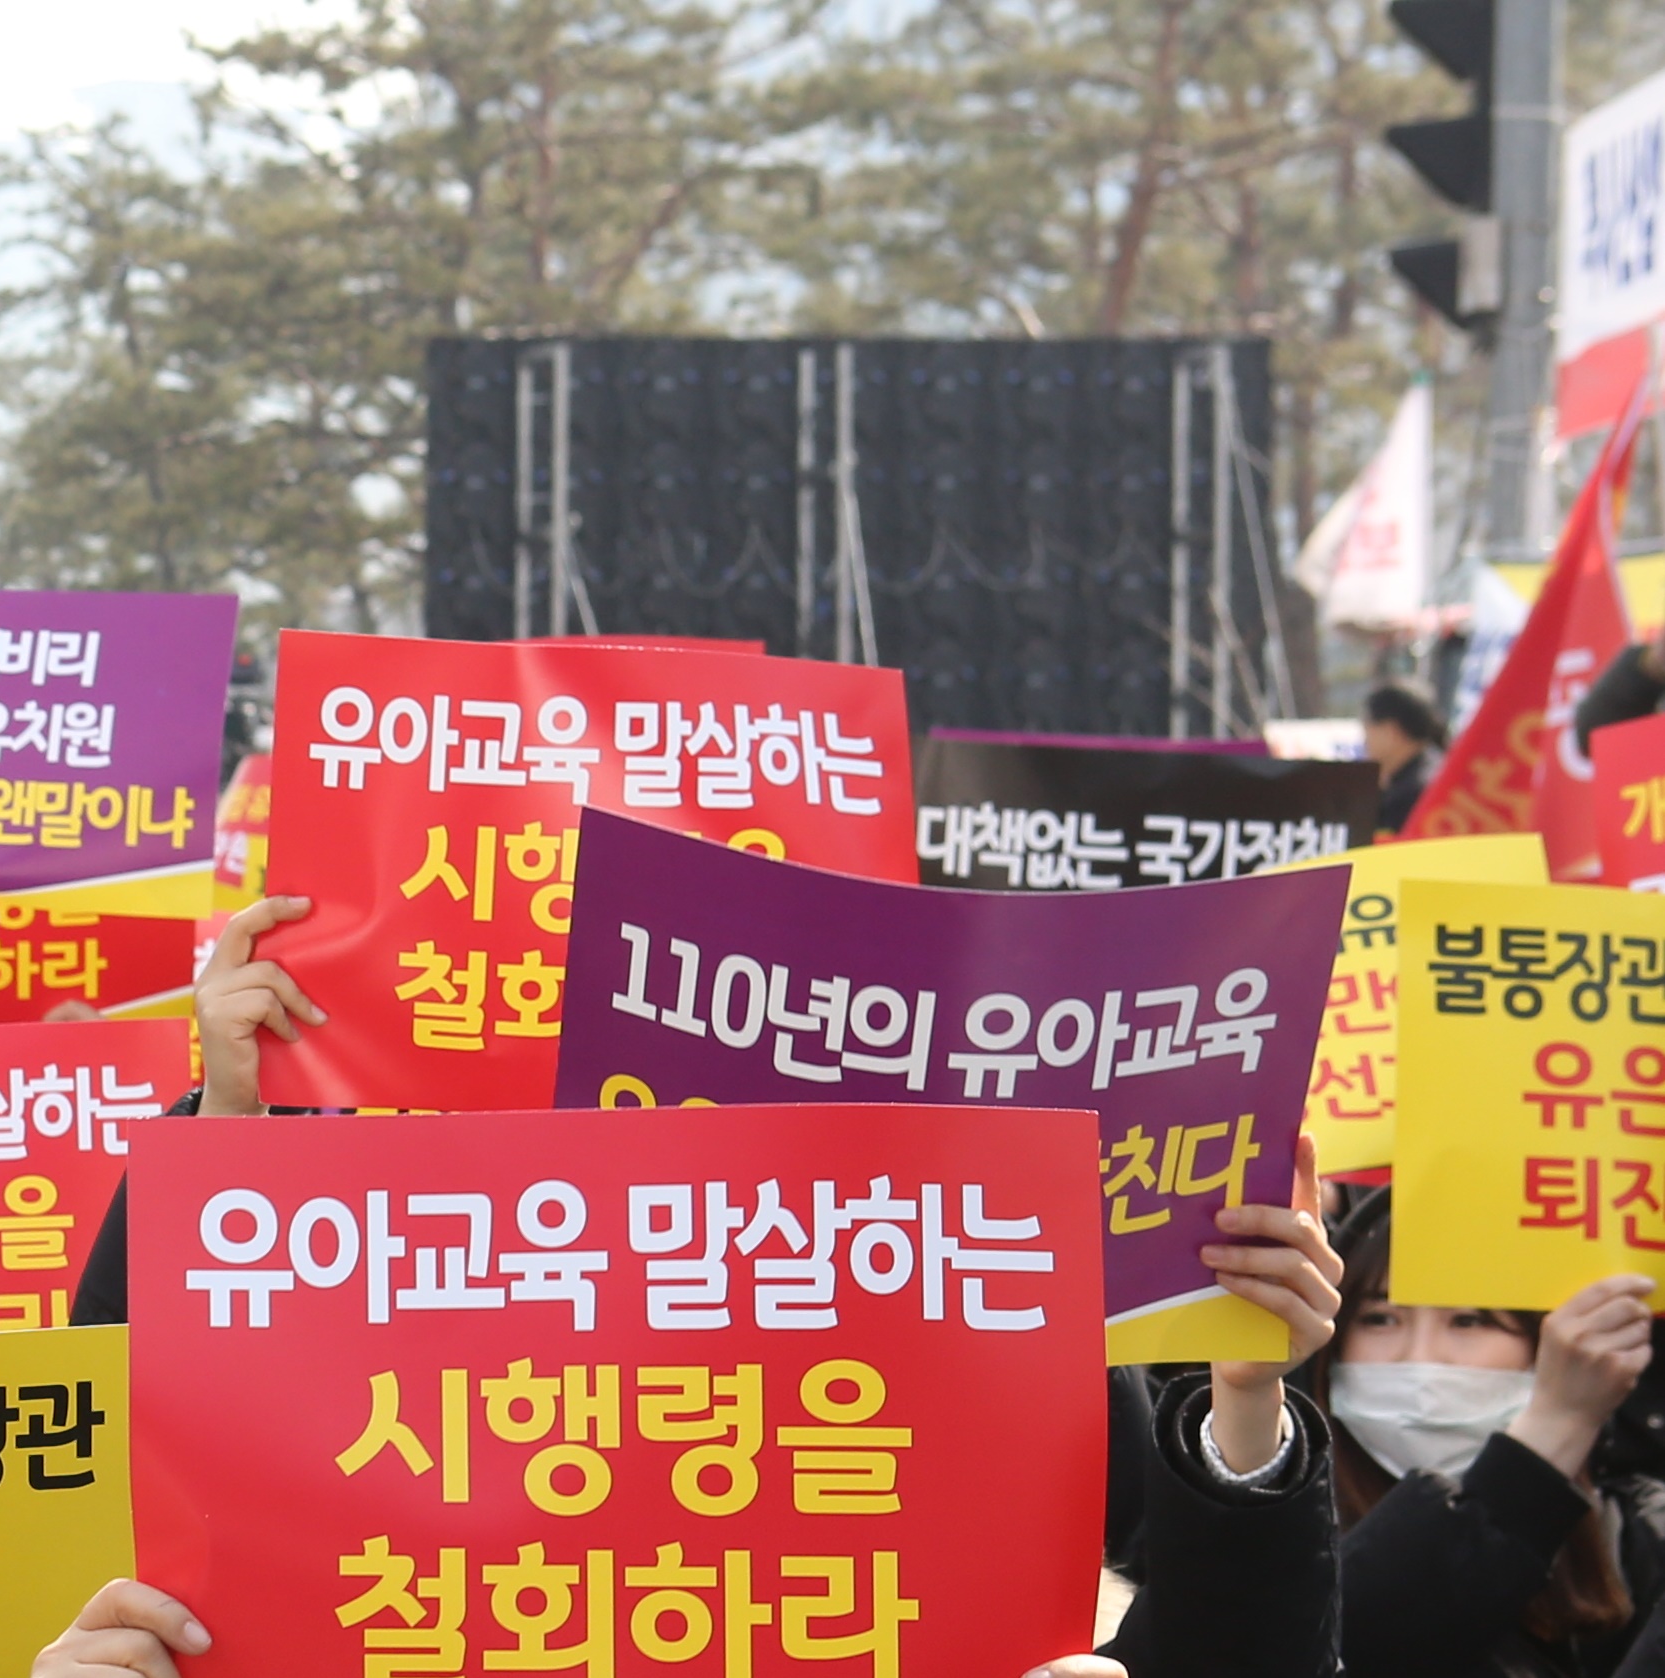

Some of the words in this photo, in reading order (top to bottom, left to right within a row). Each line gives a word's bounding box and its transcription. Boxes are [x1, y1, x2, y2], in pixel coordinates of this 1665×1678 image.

[309, 686, 601, 808] 유아교육
[612, 700, 884, 817] 말살하는
[915, 801, 1130, 890] 대책없는
[612, 922, 938, 1092] 110년의
[947, 967, 1277, 1098] 유아교육
[1523, 1041, 1665, 1139] 유은
[1101, 1113, 1262, 1236] 친다
[1519, 1155, 1665, 1252] 퇴진
[184, 1179, 609, 1333] 유아교육
[626, 1174, 1057, 1333] 말살하는
[333, 1356, 914, 1518] 시행령을
